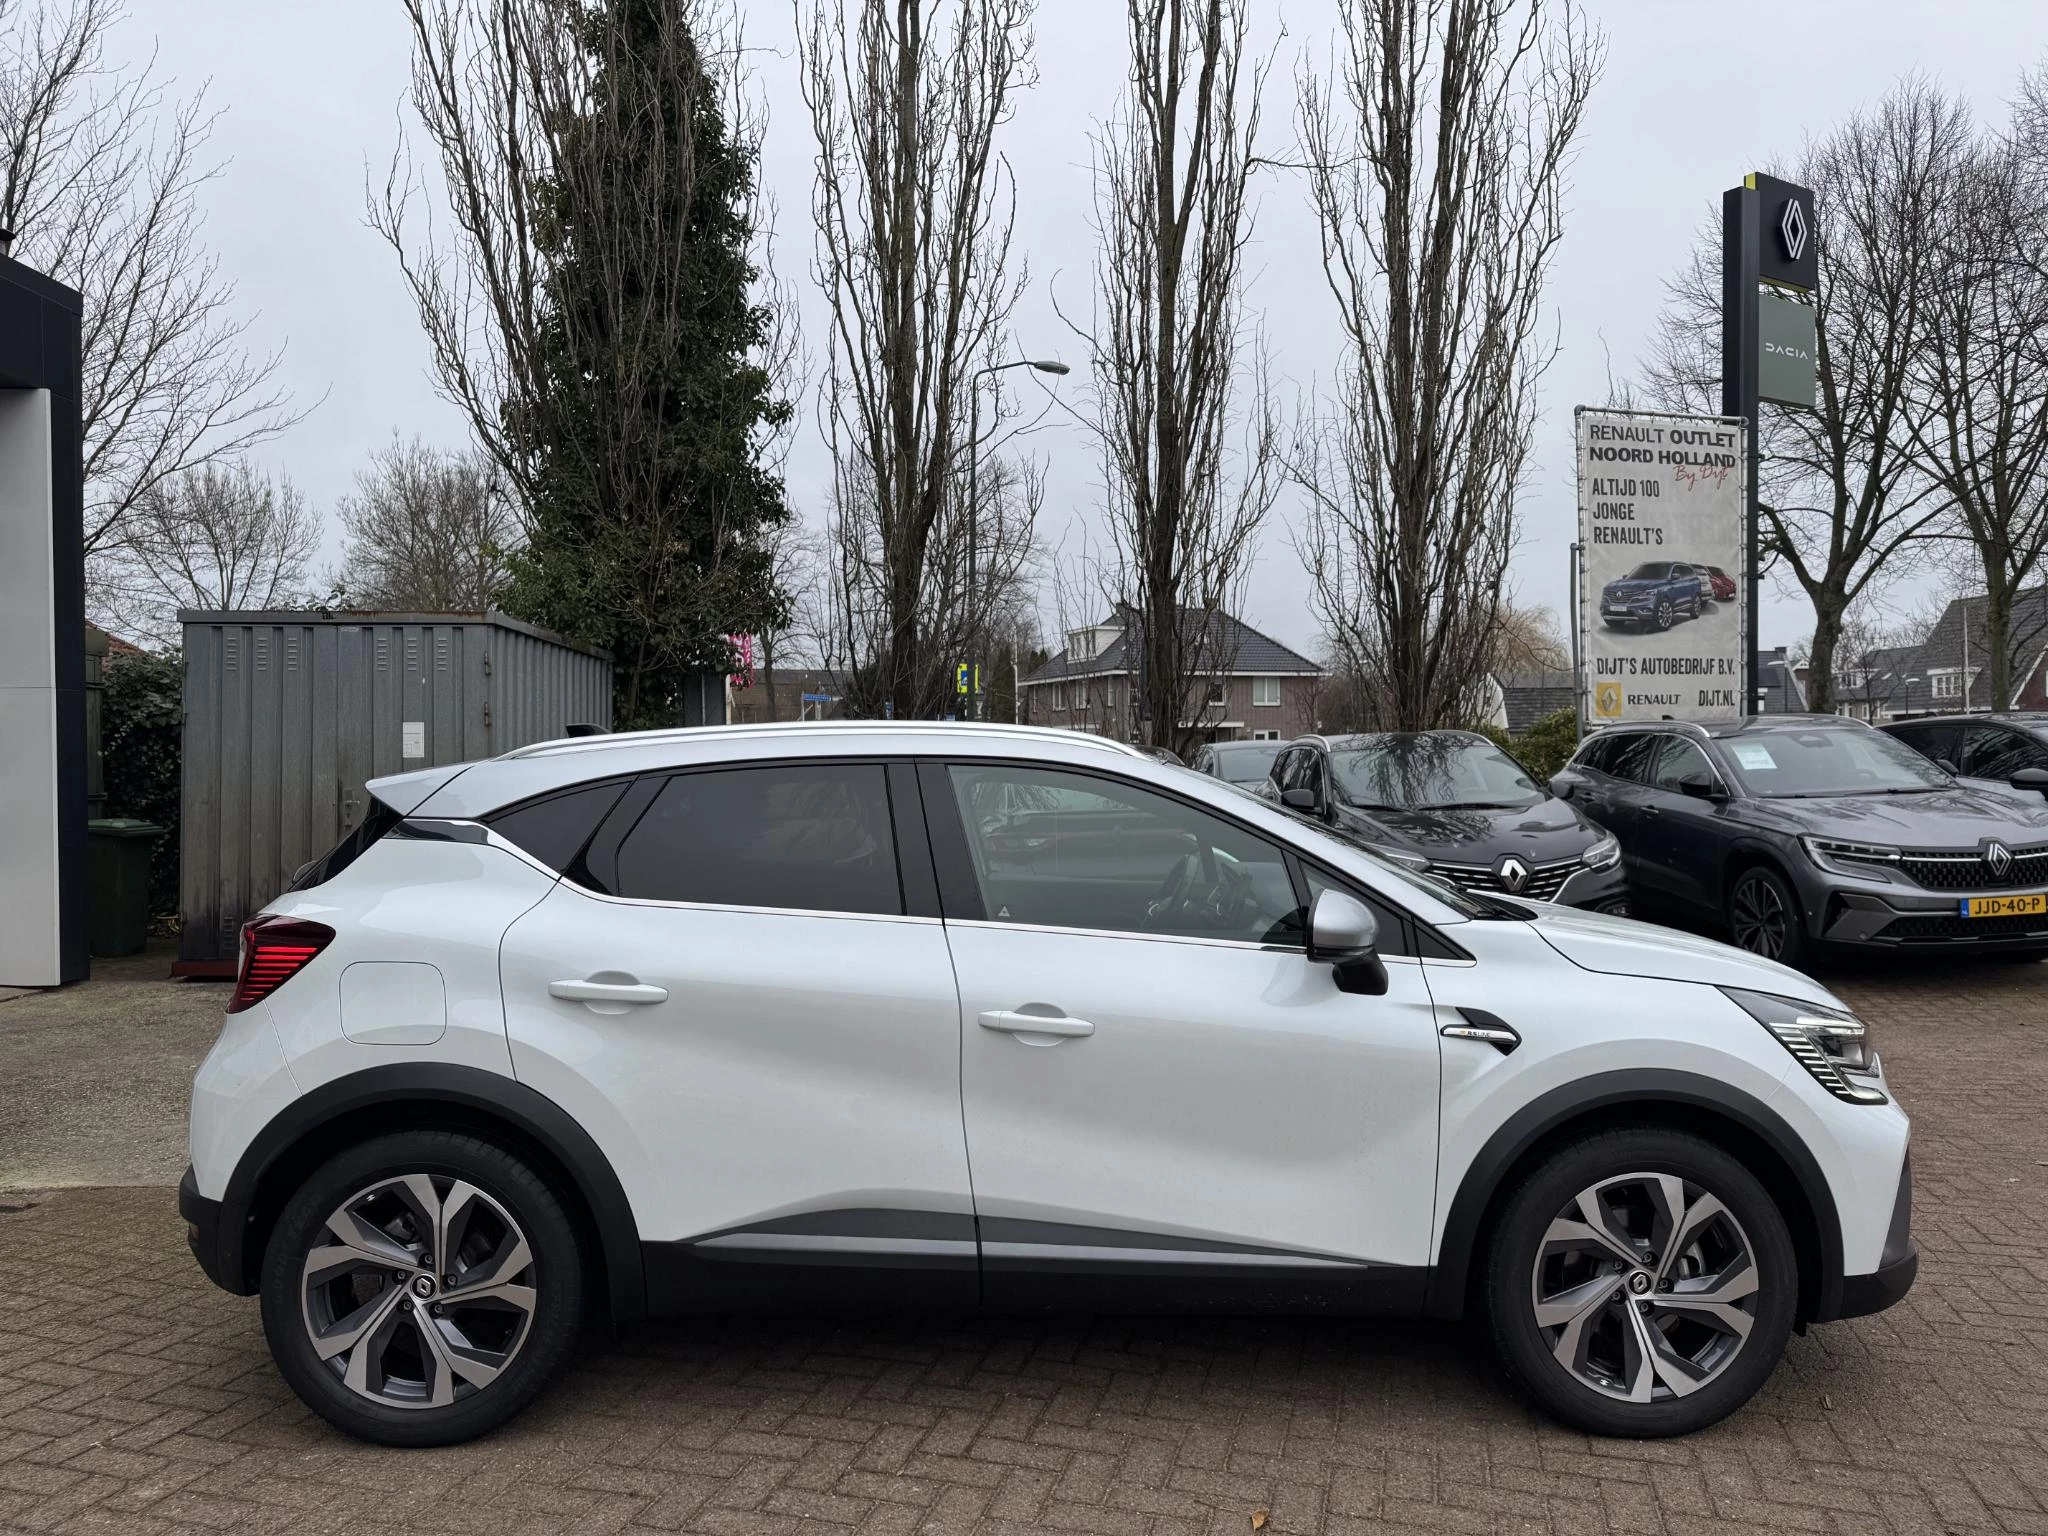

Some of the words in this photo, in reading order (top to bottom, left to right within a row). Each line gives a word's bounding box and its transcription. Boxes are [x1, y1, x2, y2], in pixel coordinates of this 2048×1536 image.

[1765, 342, 1808, 360] DACIA
[1590, 424, 1664, 443] RENAULT
[1670, 429, 1735, 448] OUTLET
[1589, 446, 1654, 463] NOORD
[1658, 450, 1736, 468] HOLLAND
[1592, 477, 1637, 496] ALTIJD
[1640, 479, 1660, 498] 100
[1593, 502, 1635, 520] JONGE
[1593, 526, 1663, 545] RENAULT'S
[1597, 657, 1637, 675] DIJT'S
[1640, 657, 1715, 675] AUTOBEDRIJF
[1718, 658, 1735, 675] B.V.
[1627, 694, 1681, 705] RENAULT
[1698, 689, 1735, 707] DIJT.NL
[1975, 897, 2040, 914] JJD-40-P
